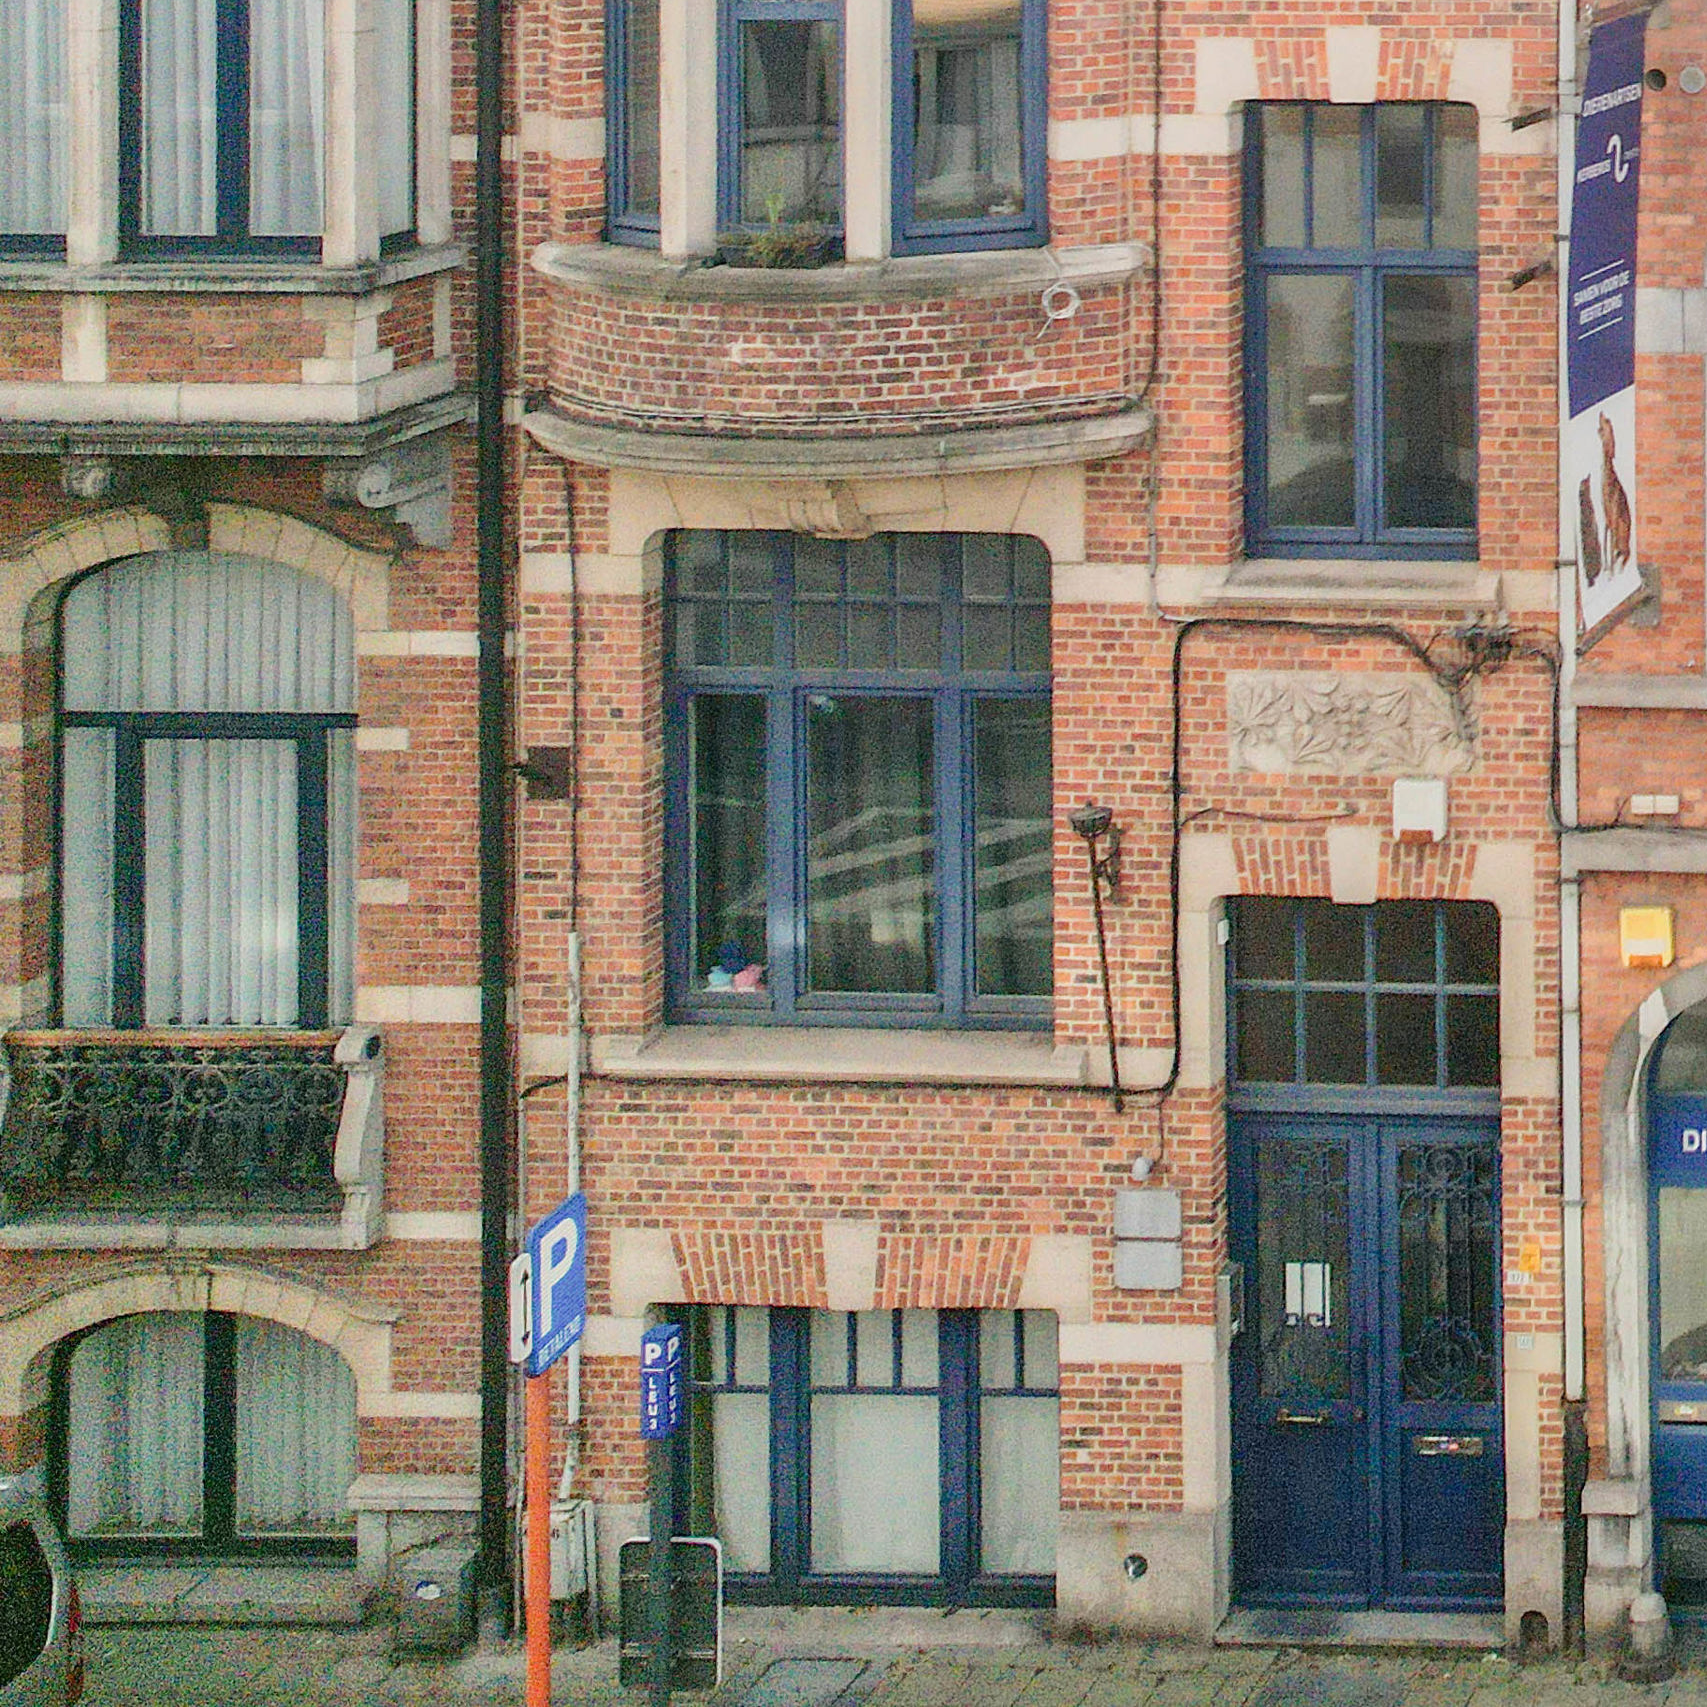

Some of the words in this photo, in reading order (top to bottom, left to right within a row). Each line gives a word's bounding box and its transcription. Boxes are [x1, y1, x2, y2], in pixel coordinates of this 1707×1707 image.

[540, 1217, 577, 1338] P
[645, 1343, 662, 1365] P
[668, 1336, 679, 1362] P
